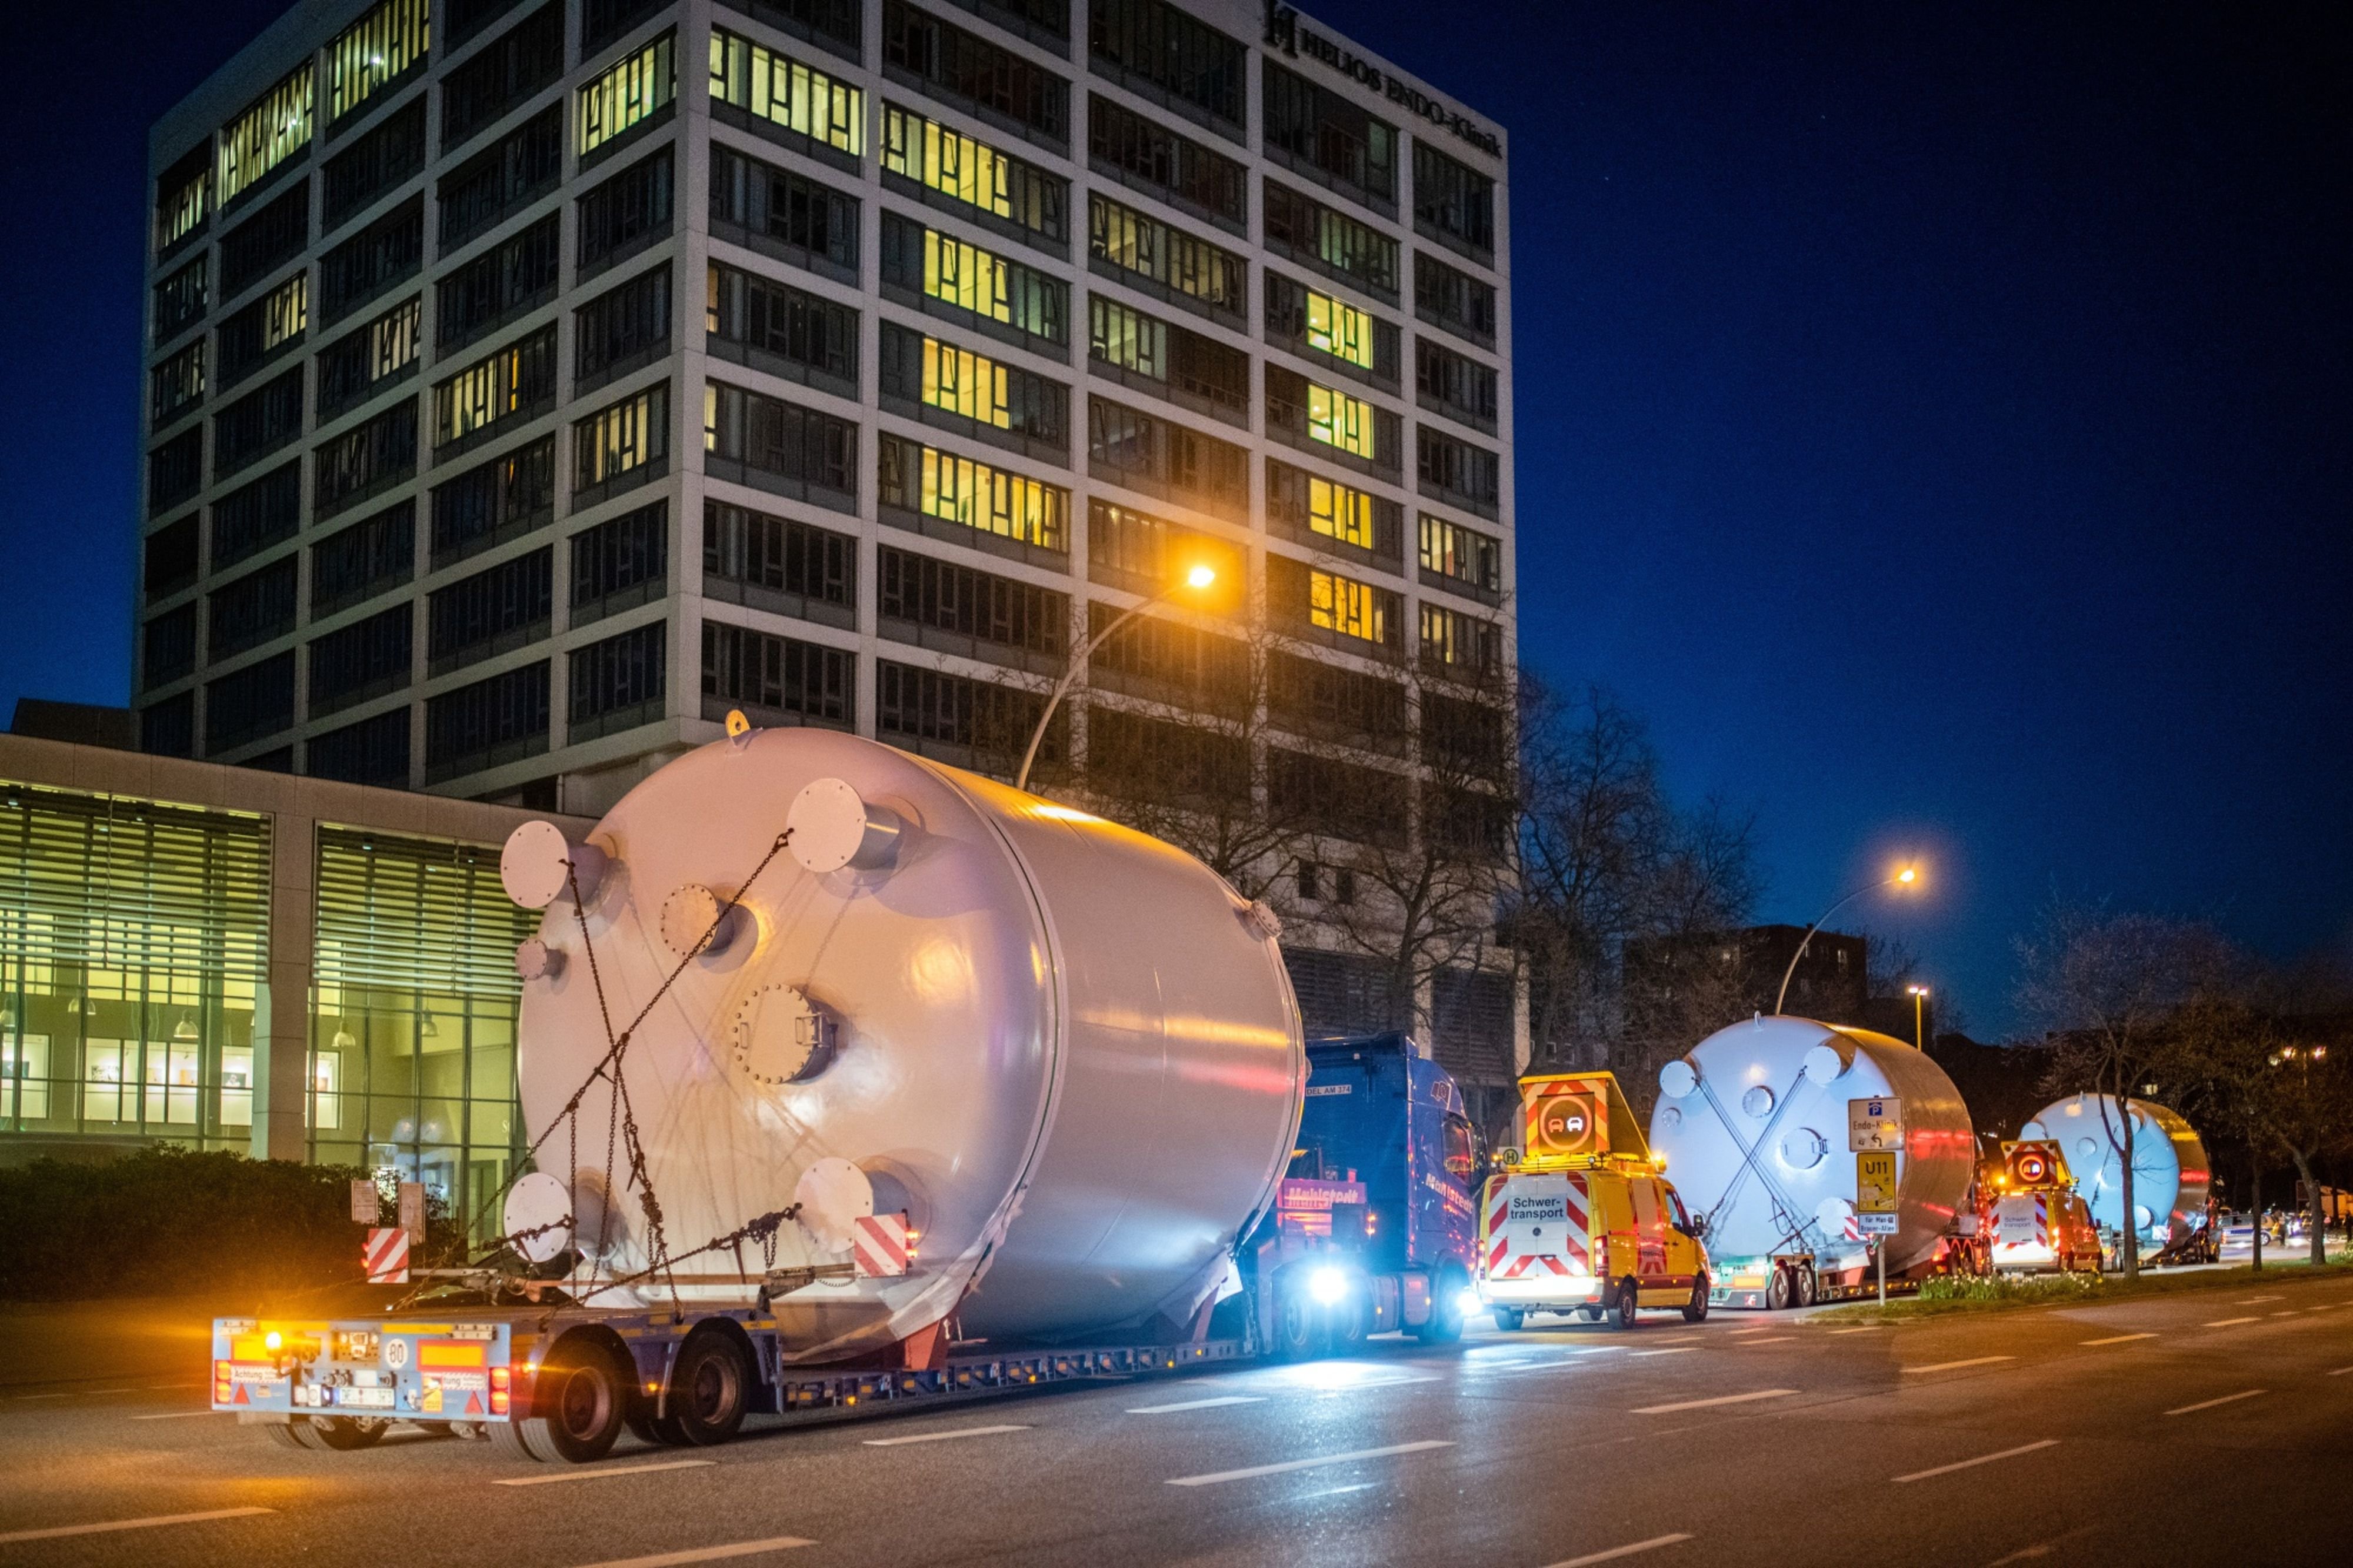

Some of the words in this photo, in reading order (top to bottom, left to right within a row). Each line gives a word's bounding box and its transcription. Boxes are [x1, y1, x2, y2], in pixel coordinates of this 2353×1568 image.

[1299, 28, 1381, 91] HELIOS
[1853, 1120, 1898, 1130] Endo-Klinik
[1866, 1162, 1887, 1175] U11
[1514, 1197, 1561, 1208] Schwer-
[1511, 1207, 1564, 1220] transport
[389, 1343, 404, 1363] 80
[234, 1369, 263, 1380] Achtung
